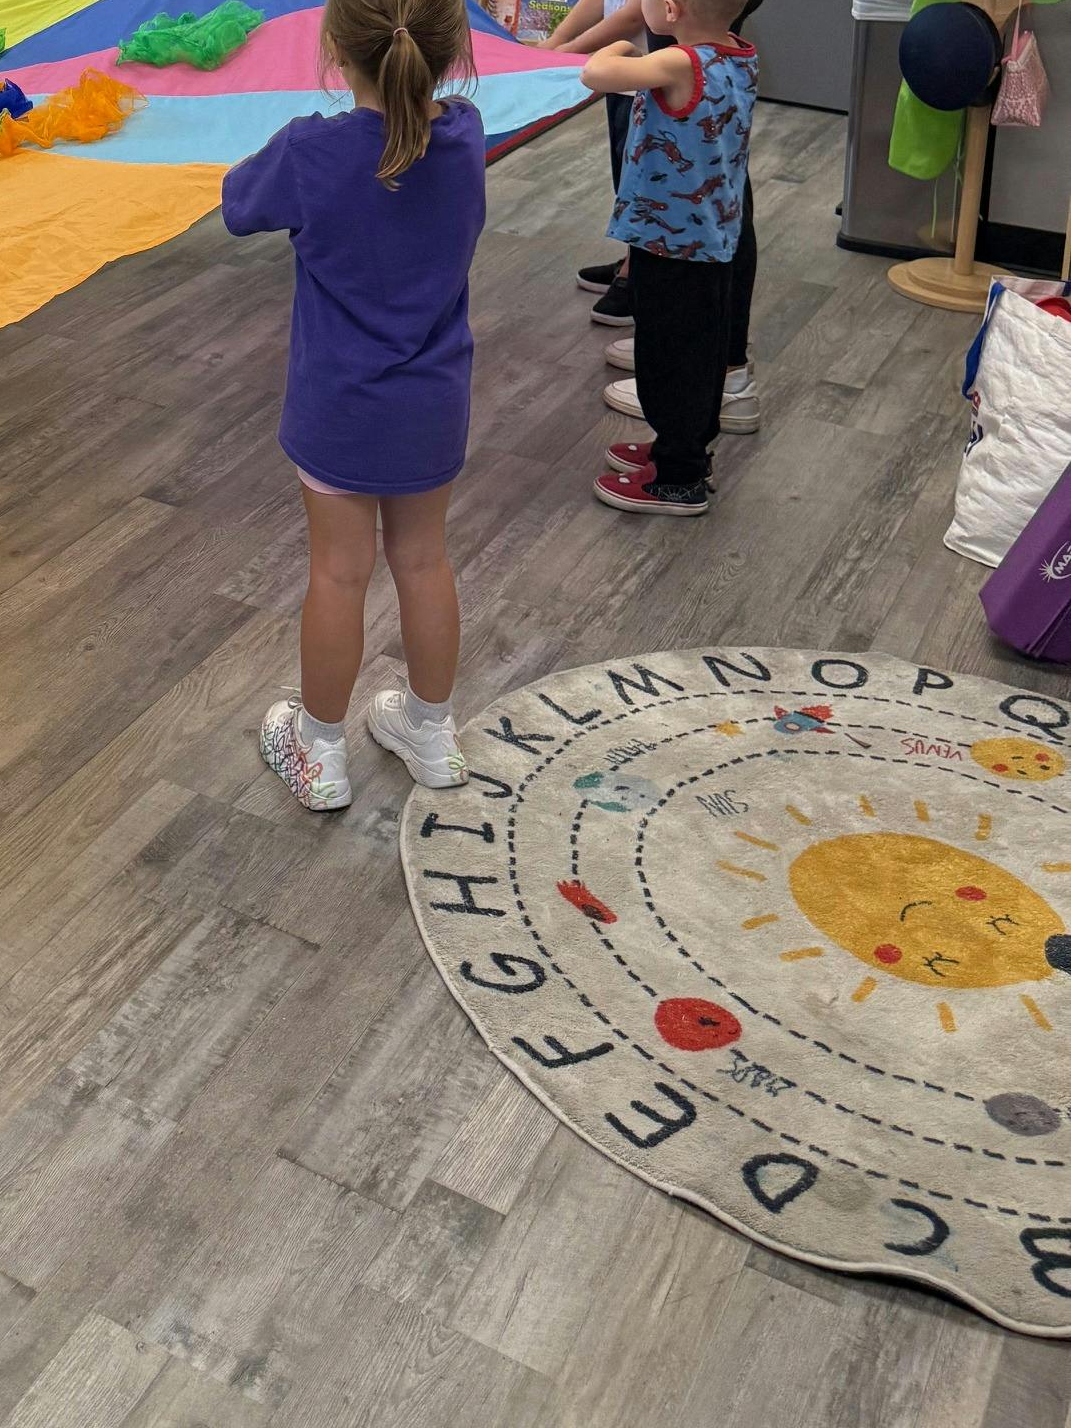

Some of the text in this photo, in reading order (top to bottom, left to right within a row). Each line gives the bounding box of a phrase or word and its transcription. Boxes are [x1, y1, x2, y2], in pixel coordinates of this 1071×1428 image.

[605, 663, 684, 707] M
[702, 652, 772, 689] N
[810, 658, 869, 690] O
[913, 668, 954, 696] P
[538, 691, 601, 729] L
[999, 694, 1071, 740] Q
[482, 715, 555, 755] K
[901, 737, 962, 761] VENUS
[420, 812, 495, 843] I
[424, 868, 507, 917] H
[460, 952, 547, 995] G
[511, 1031, 614, 1069] F
[605, 1081, 697, 1150] E
[743, 1152, 818, 1214] D
[883, 1198, 949, 1256] C
